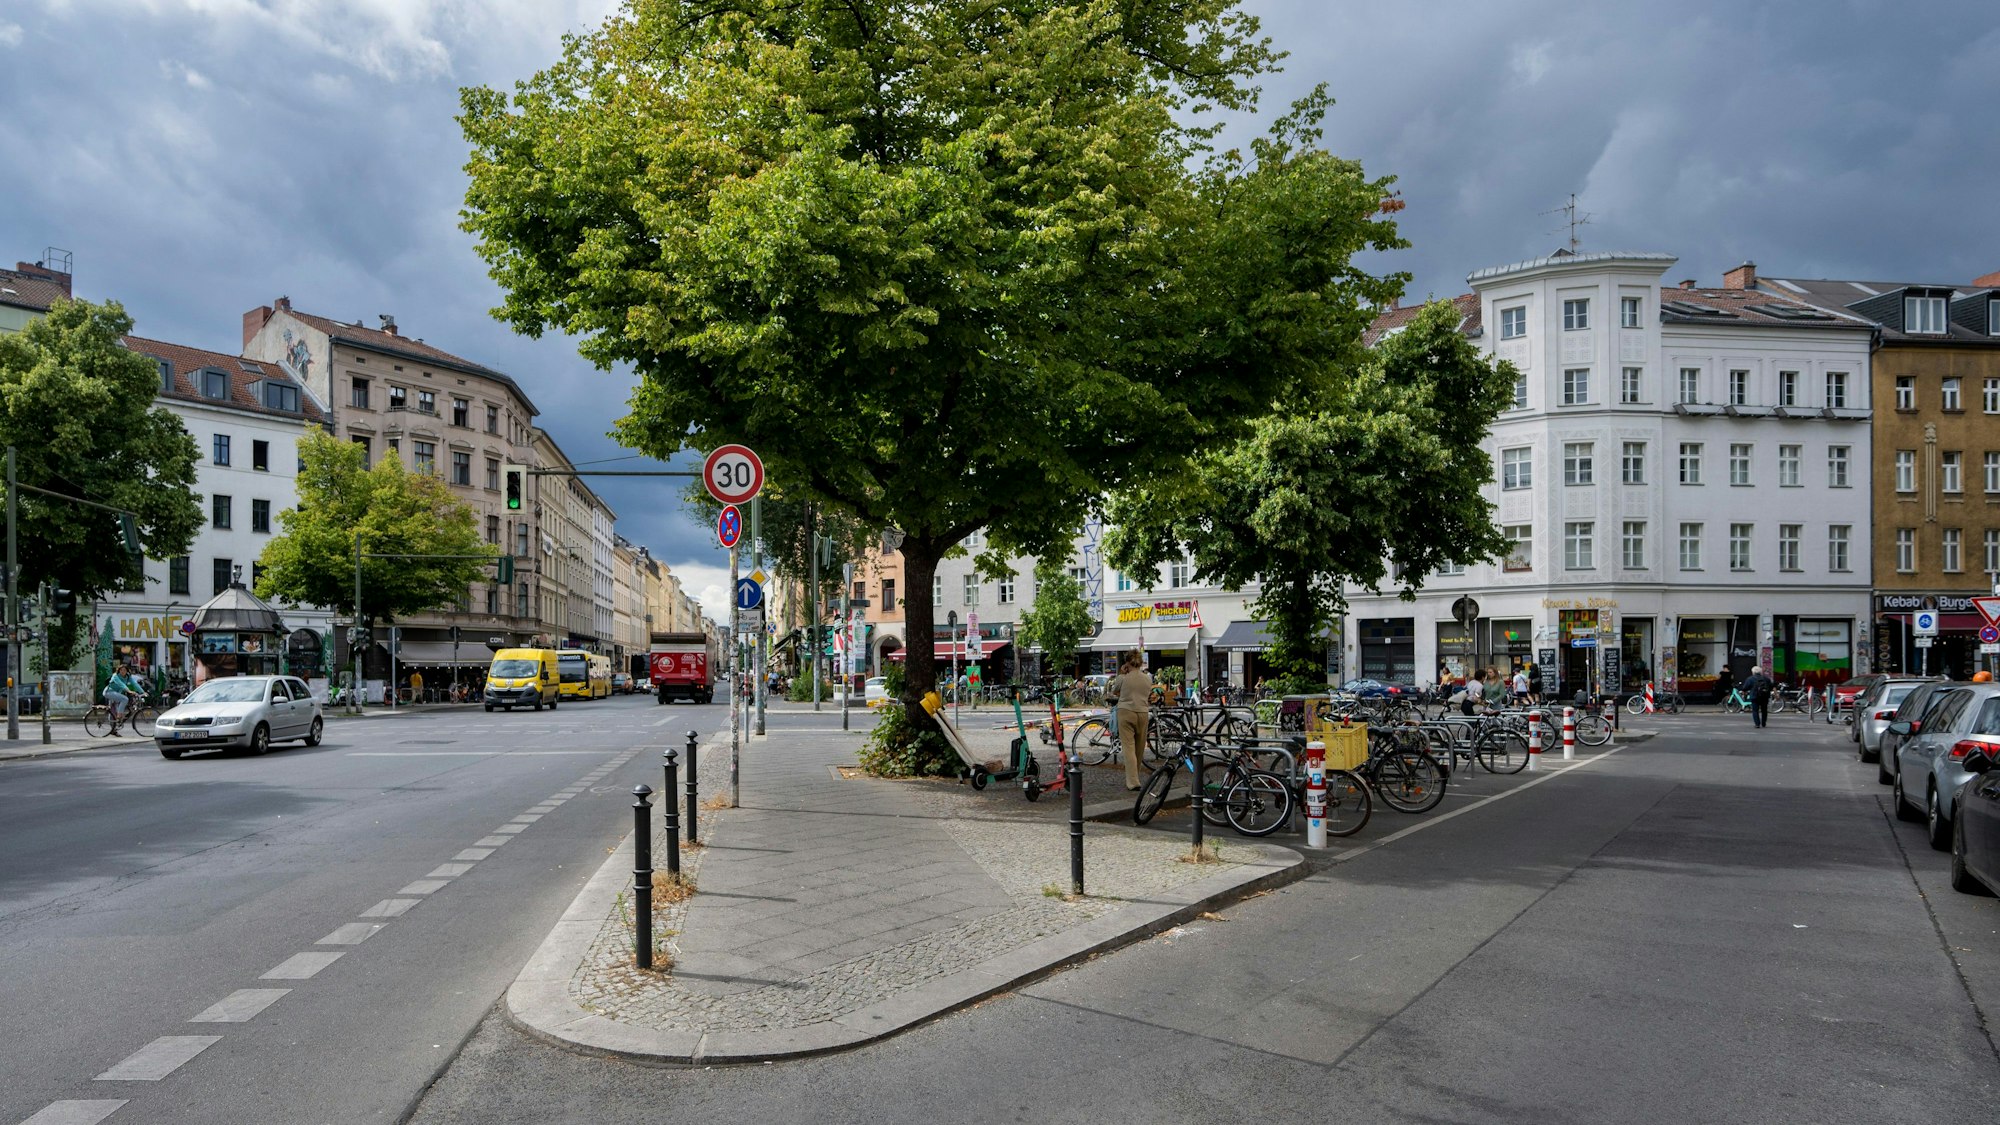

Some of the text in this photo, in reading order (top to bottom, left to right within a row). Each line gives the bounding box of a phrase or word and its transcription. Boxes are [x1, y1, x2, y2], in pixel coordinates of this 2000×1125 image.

[717, 462, 750, 488] 30
[1884, 596, 1919, 607] Kebab
[1118, 606, 1153, 623] ANGRY
[1155, 608, 1190, 616] CHICKEN
[121, 616, 182, 638] HANF
